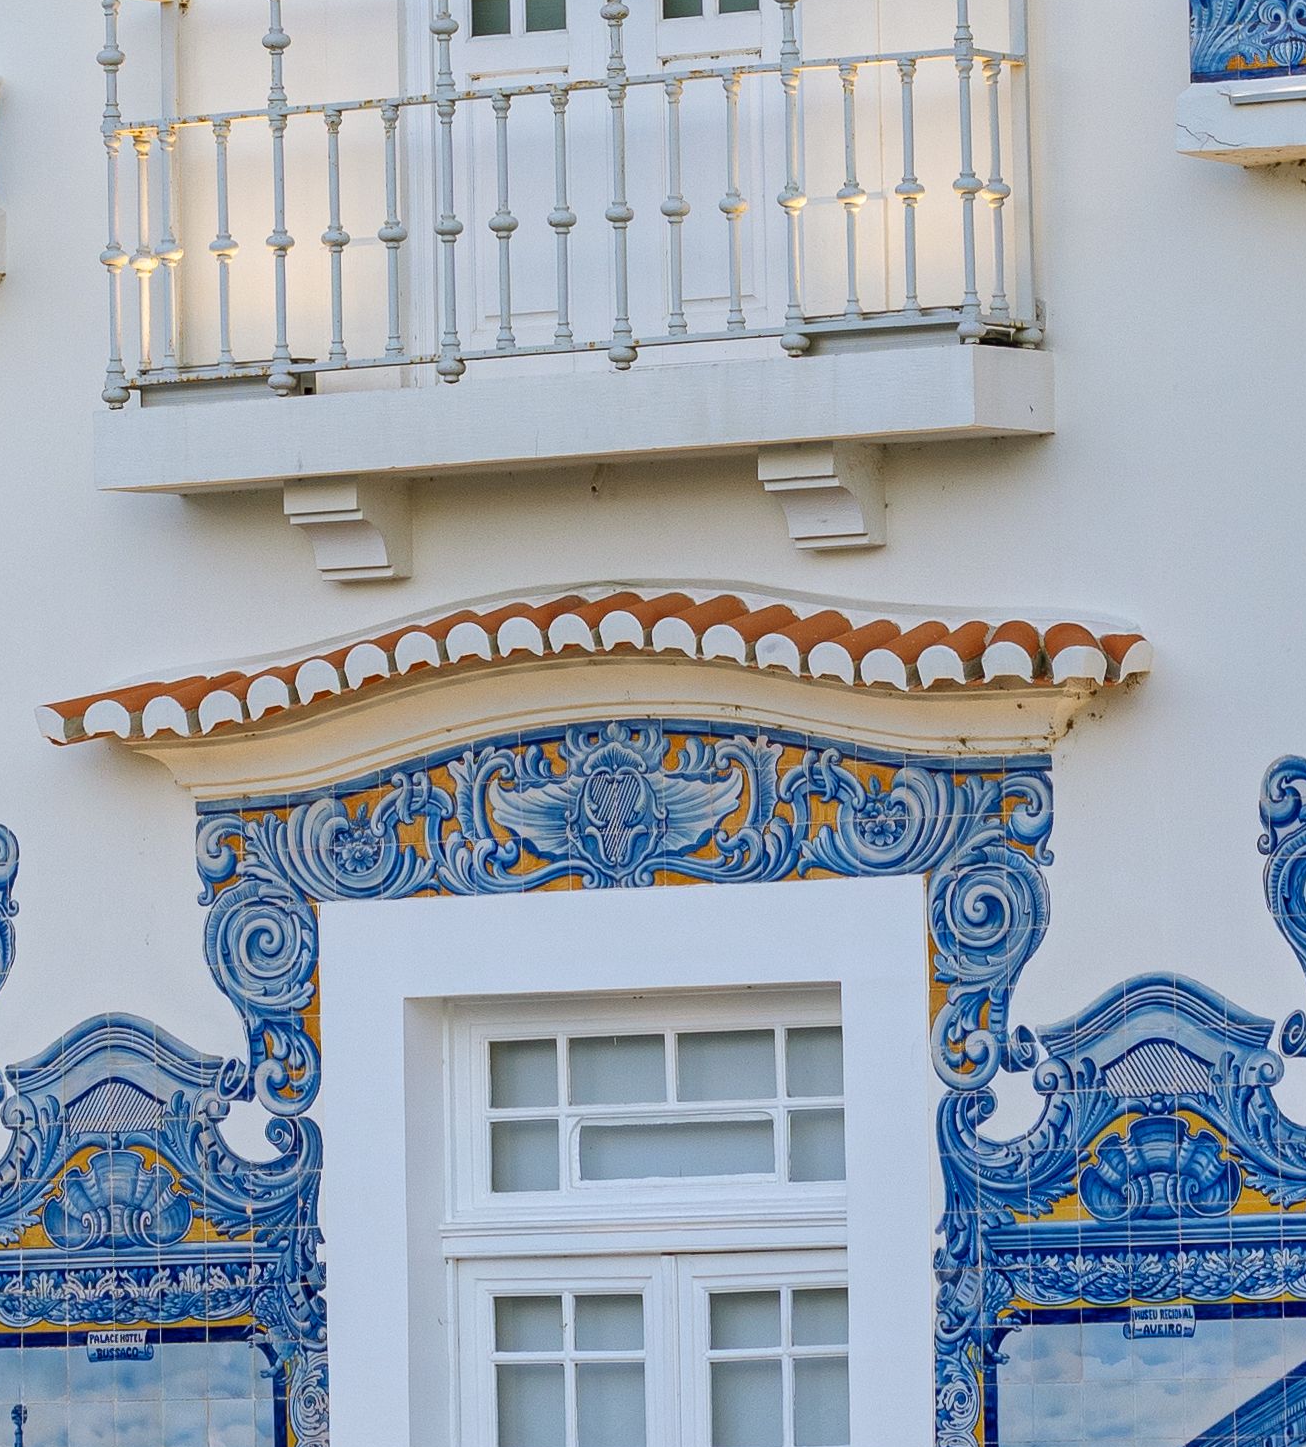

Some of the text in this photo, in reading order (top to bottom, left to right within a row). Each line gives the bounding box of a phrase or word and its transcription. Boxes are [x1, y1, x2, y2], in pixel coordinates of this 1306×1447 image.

[1134, 1309, 1158, 1320] MUSEU
[89, 1333, 143, 1345] PALACE HOTEL
